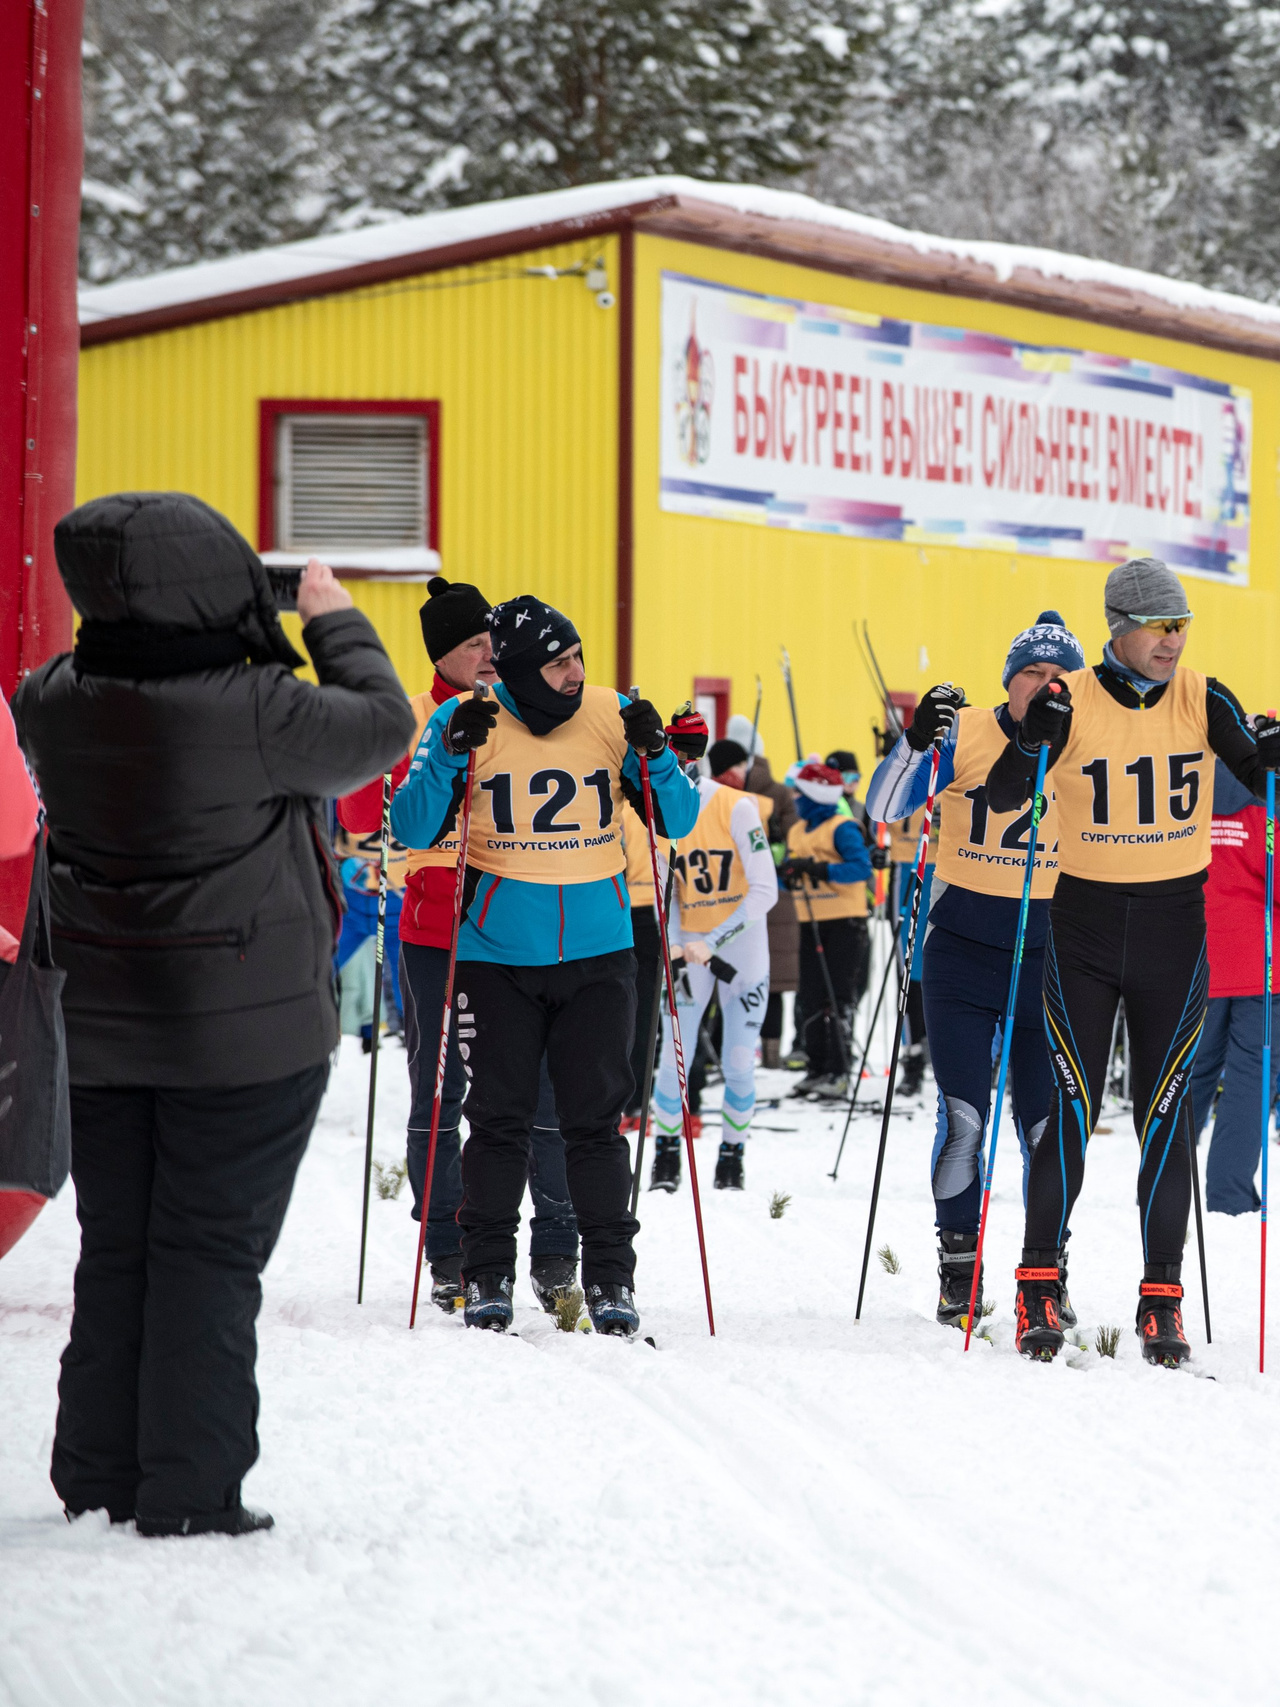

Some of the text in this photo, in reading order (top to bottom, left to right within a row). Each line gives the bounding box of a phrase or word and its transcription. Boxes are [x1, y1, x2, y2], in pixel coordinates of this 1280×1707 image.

[733, 354, 1204, 518] БЫСТРЕЕ! ВЫШЕ! СИЛЬНЕЕ! ВМЕСТЕ!
[479, 767, 615, 835] 121
[1080, 751, 1205, 827] 115
[963, 782, 1058, 854] 12
[1081, 830, 1164, 844] СУРГУТСКИЙ
[1167, 824, 1199, 842] РАЙОН
[487, 831, 616, 851] СУРГУТСКИЙ РАЙОН
[958, 847, 1042, 867] СУРГУТСКИЙ
[674, 848, 733, 894] 137
[1055, 1053, 1076, 1086] CRAFT
[1158, 1079, 1181, 1114] CRAFT
[955, 1109, 982, 1131] BRIKO
